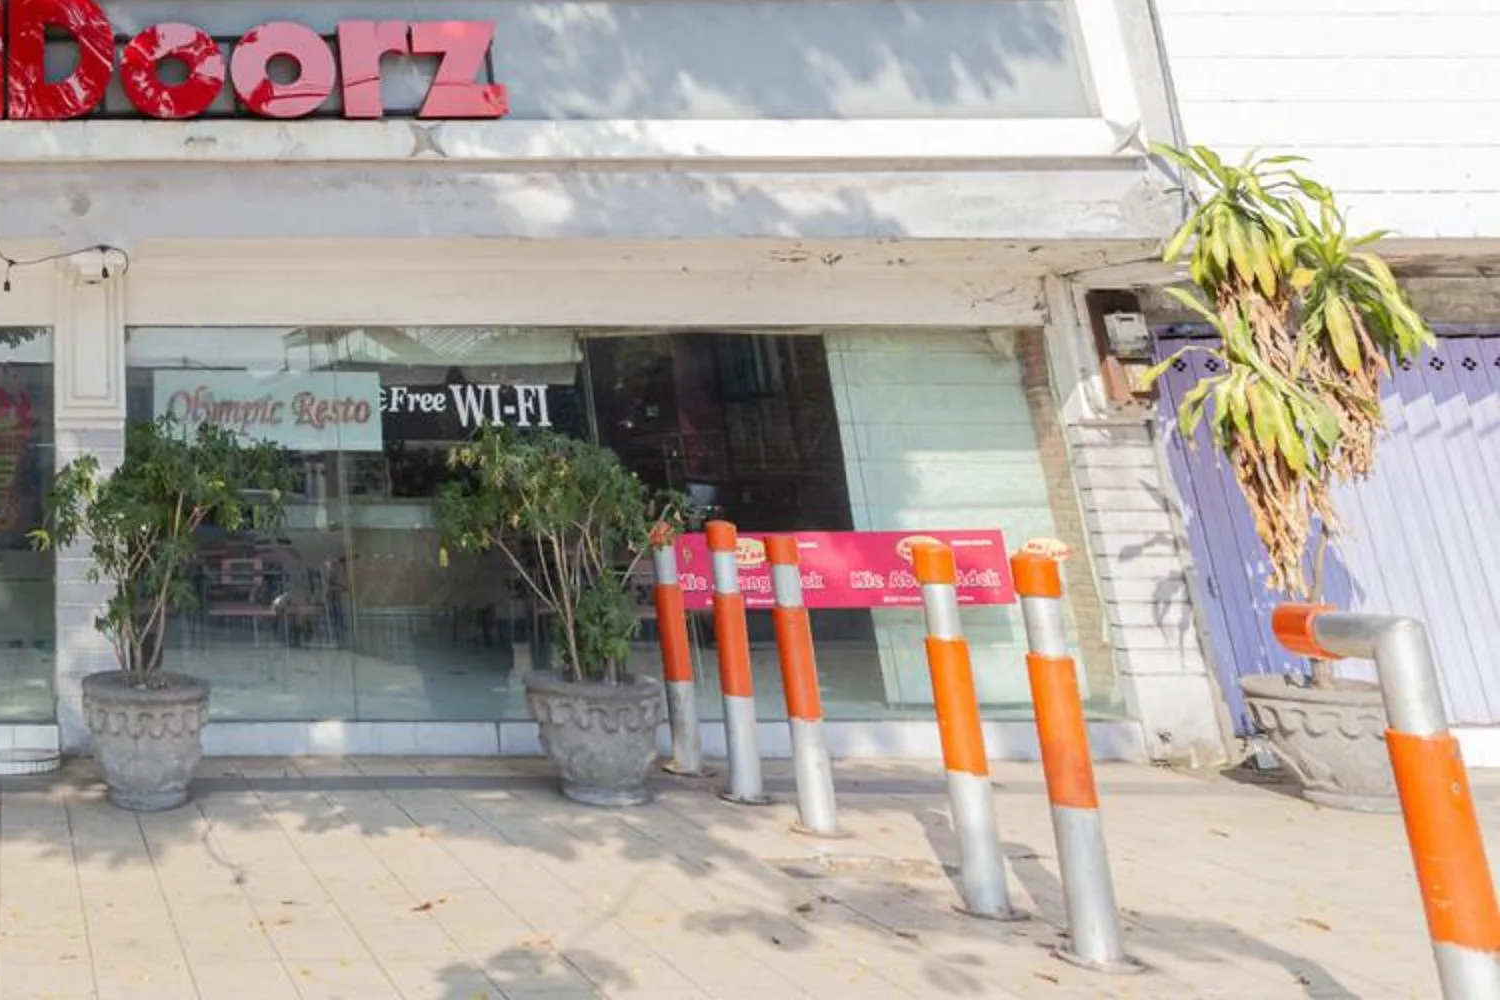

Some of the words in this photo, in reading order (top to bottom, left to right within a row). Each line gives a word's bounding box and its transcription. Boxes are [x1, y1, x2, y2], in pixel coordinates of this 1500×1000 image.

[292, 391, 372, 429] Resto
[388, 387, 446, 412] Free
[448, 384, 552, 427] WI-FI
